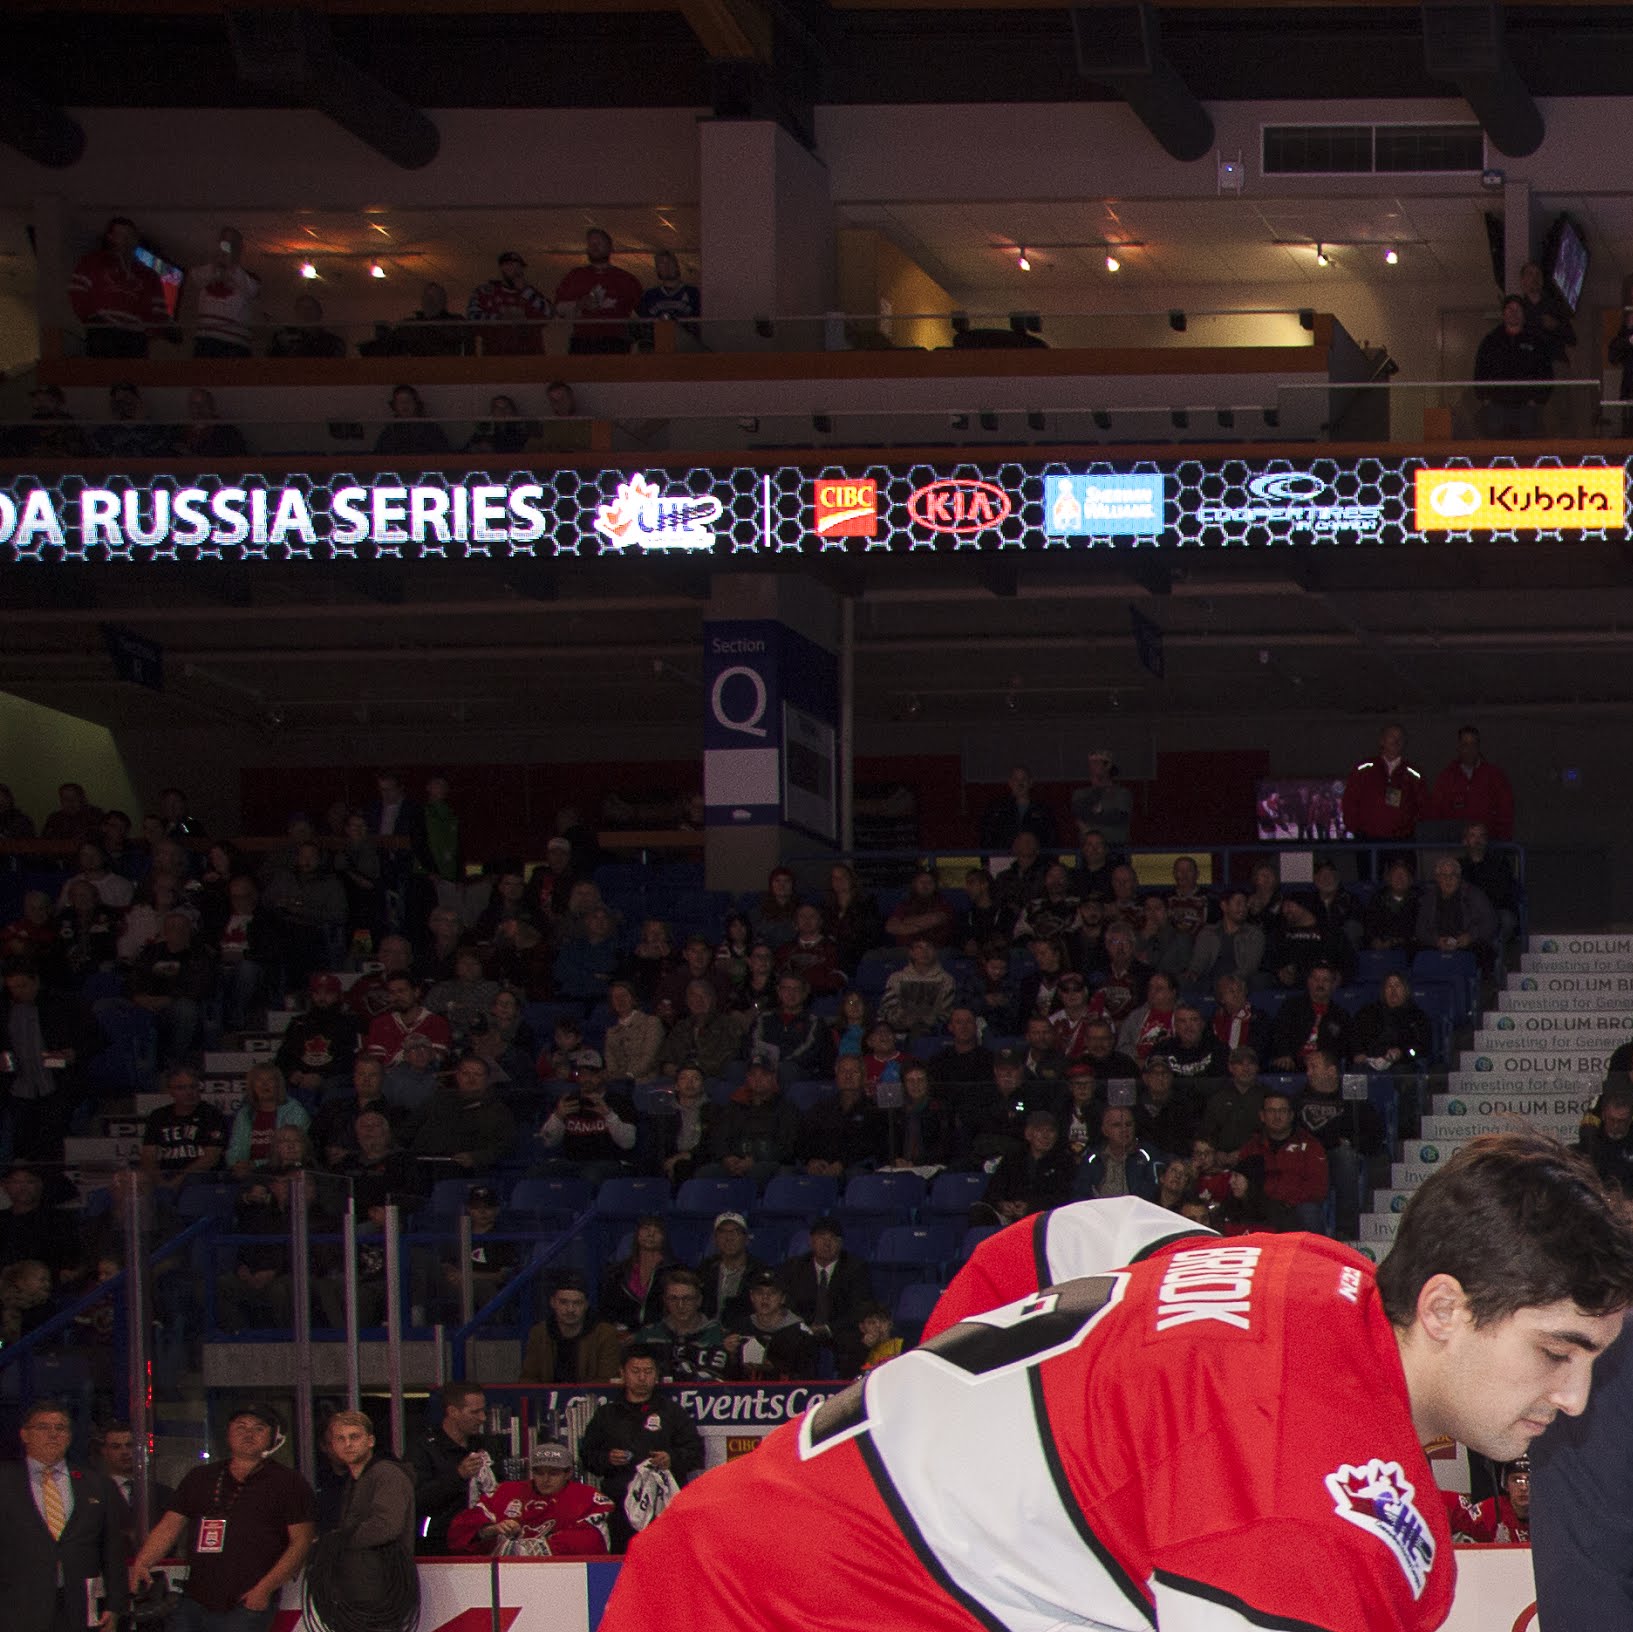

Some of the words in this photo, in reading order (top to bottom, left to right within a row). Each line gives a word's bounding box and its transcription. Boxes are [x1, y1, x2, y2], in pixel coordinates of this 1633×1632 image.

[820, 486, 873, 508] CIBC
[1489, 484, 1612, 514] Kubota
[926, 492, 994, 522] KIA
[80, 488, 316, 545] RUSSIA
[332, 485, 546, 544] SERIES
[712, 638, 765, 653] Section
[711, 666, 767, 737] Q
[1569, 939, 1631, 954] ODLUM
[1549, 978, 1612, 992] ODLUM
[1526, 1017, 1590, 1031] ODLUM
[1597, 1017, 1633, 1031] BRO
[1504, 1057, 1572, 1072] ODLUM
[1478, 1101, 1548, 1116] ODLUM
[1555, 1101, 1591, 1116] BRO
